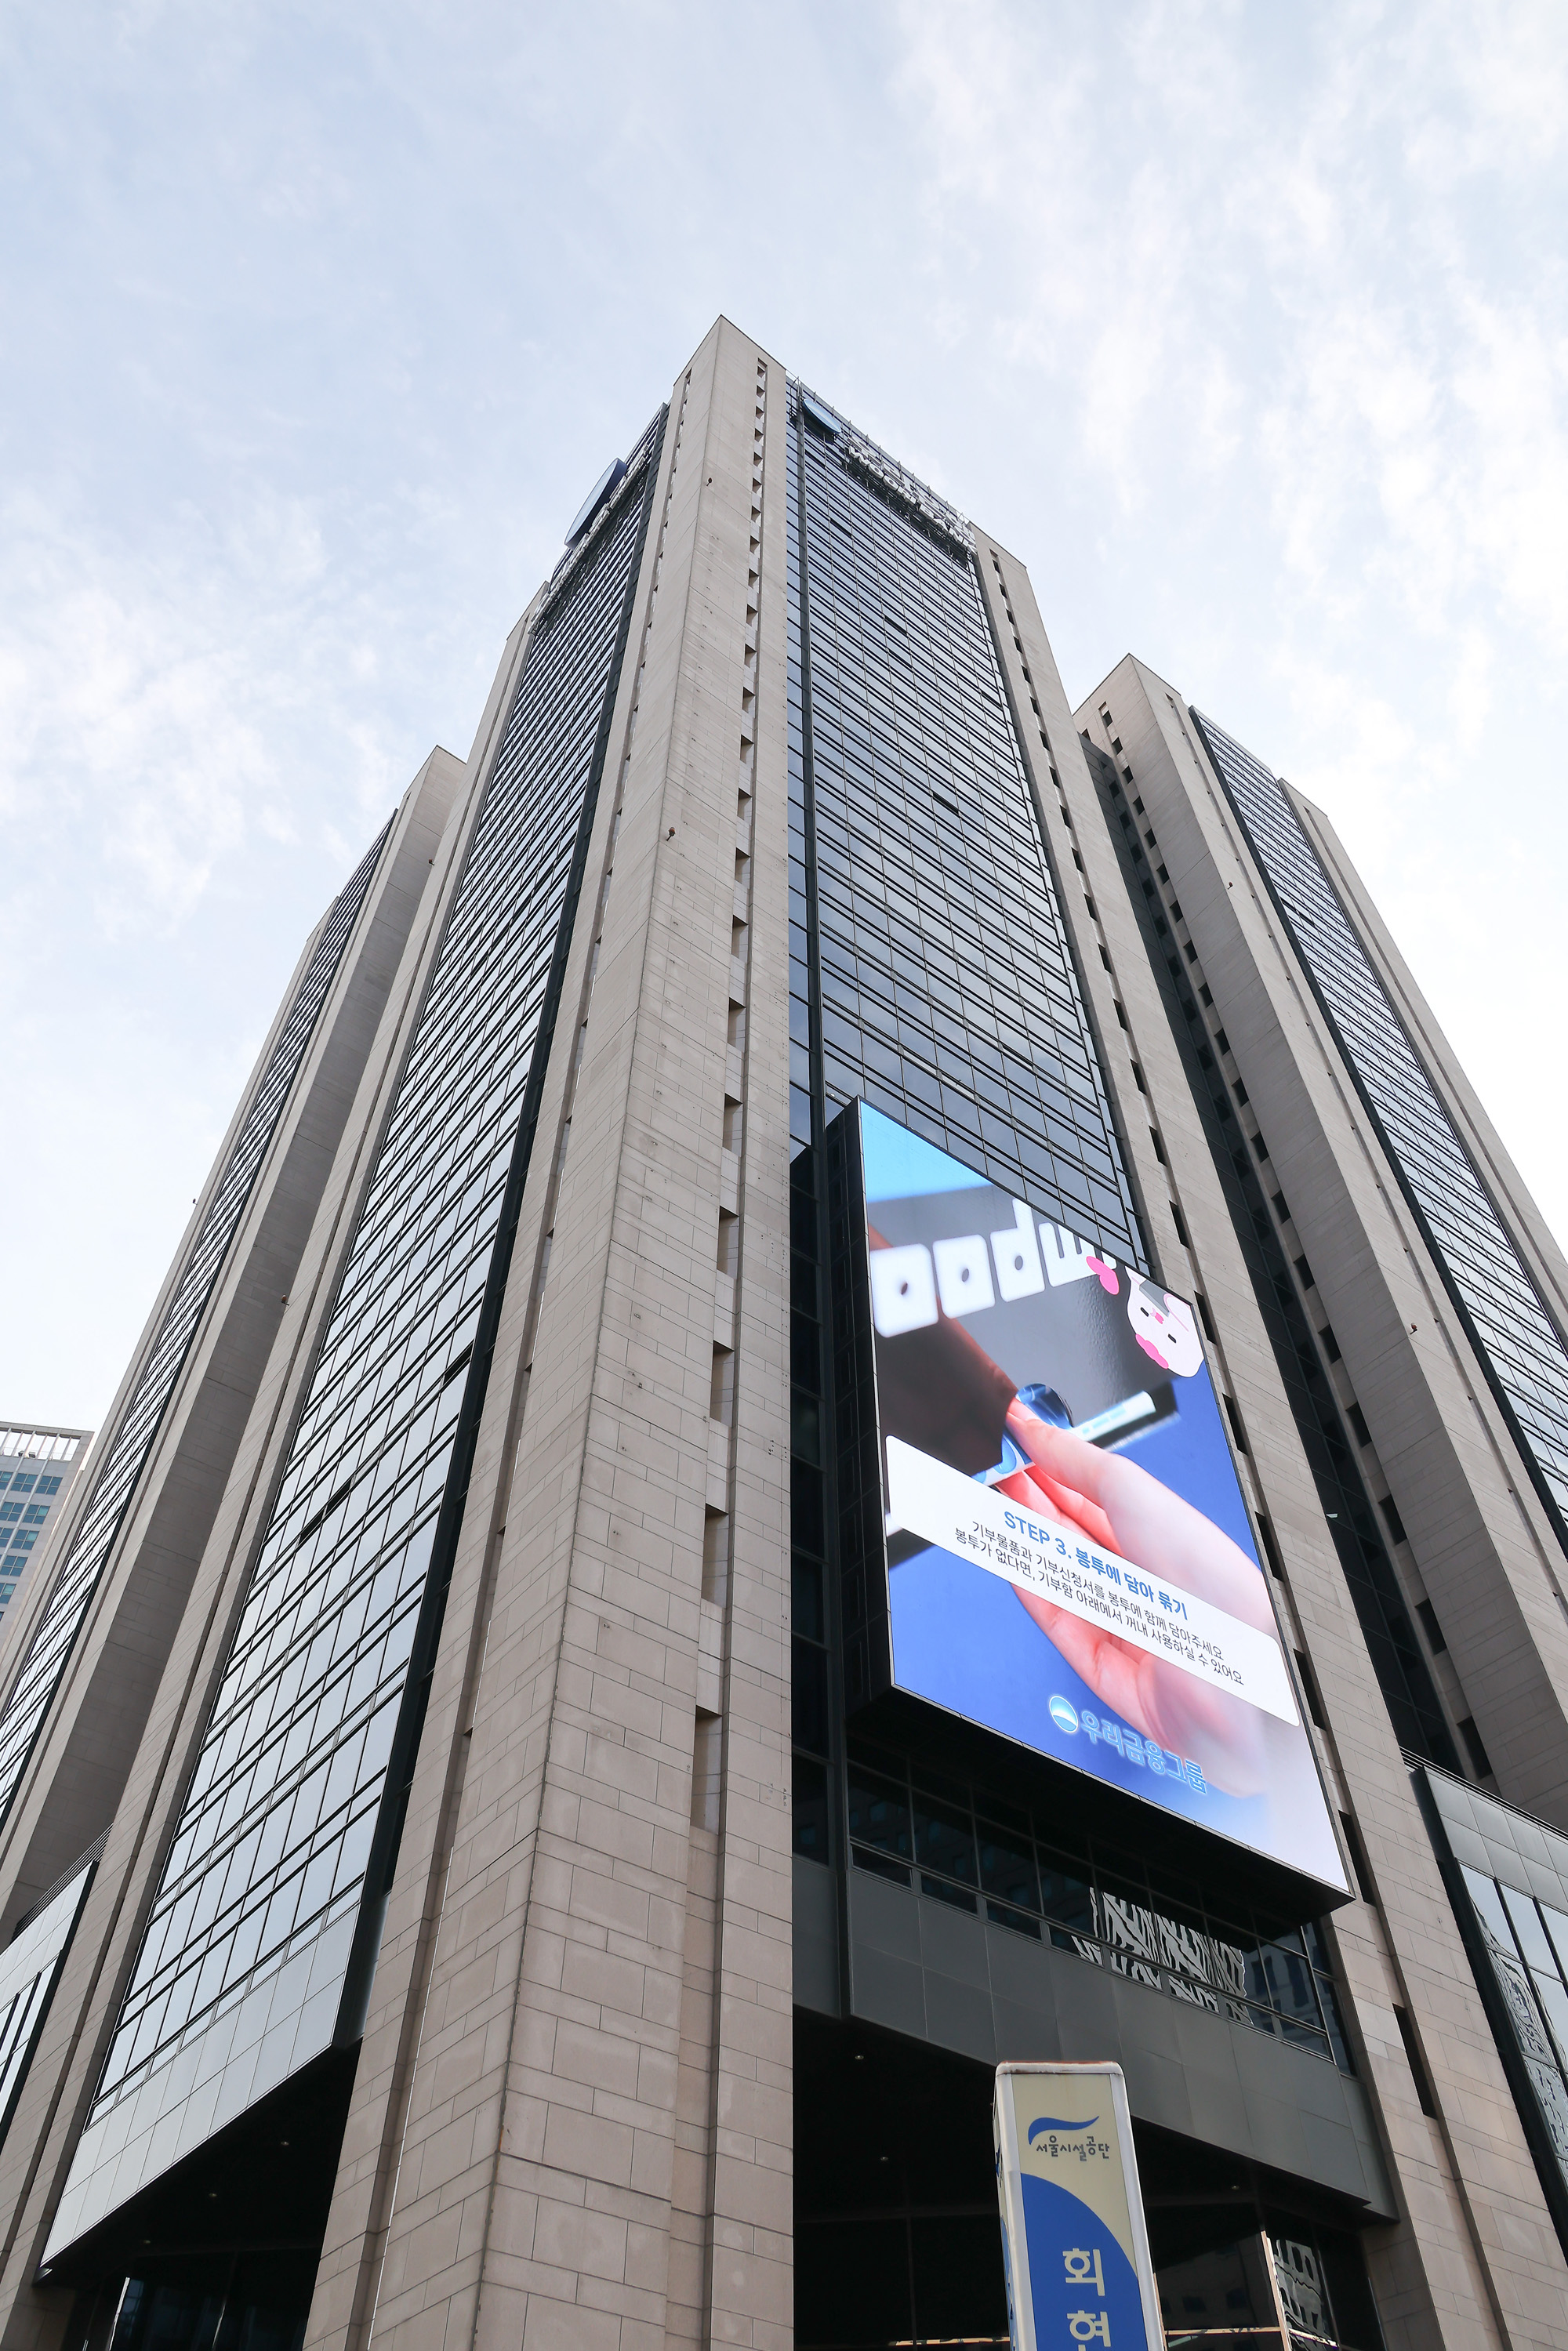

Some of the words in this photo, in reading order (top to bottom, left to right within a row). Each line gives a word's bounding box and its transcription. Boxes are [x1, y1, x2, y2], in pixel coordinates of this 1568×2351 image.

[847, 435, 977, 545] 우리은행
[848, 444, 917, 506] WOORI
[918, 502, 978, 556] BANK
[955, 1527, 993, 1557] 봉투가
[995, 1548, 1035, 1580] 없다면,
[1038, 1570, 1073, 1598] 기부함
[1076, 1590, 1123, 1624] 아래에서
[1125, 1615, 1149, 1637] 꺼내
[1151, 1628, 1195, 1662] 사용하실
[1198, 1653, 1209, 1667] 수
[1210, 1659, 1244, 1685] 있어요
[972, 1521, 1032, 1562] 기부물품과
[1036, 1554, 1105, 1600] 기부신청서를
[1108, 1591, 1142, 1619] 봉투에
[1144, 1609, 1167, 1632] 함께
[1168, 1622, 1224, 1660] 담아주세요
[1004, 1511, 1050, 1544] STEP
[1054, 1537, 1072, 1559] 3.
[1076, 1547, 1121, 1586] 봉투에
[1123, 1572, 1154, 1602] 담아
[1158, 1591, 1188, 1620] 묶기
[1080, 1710, 1207, 1794] 우리금융그룹
[1036, 2135, 1109, 2161] 서울시설공단
